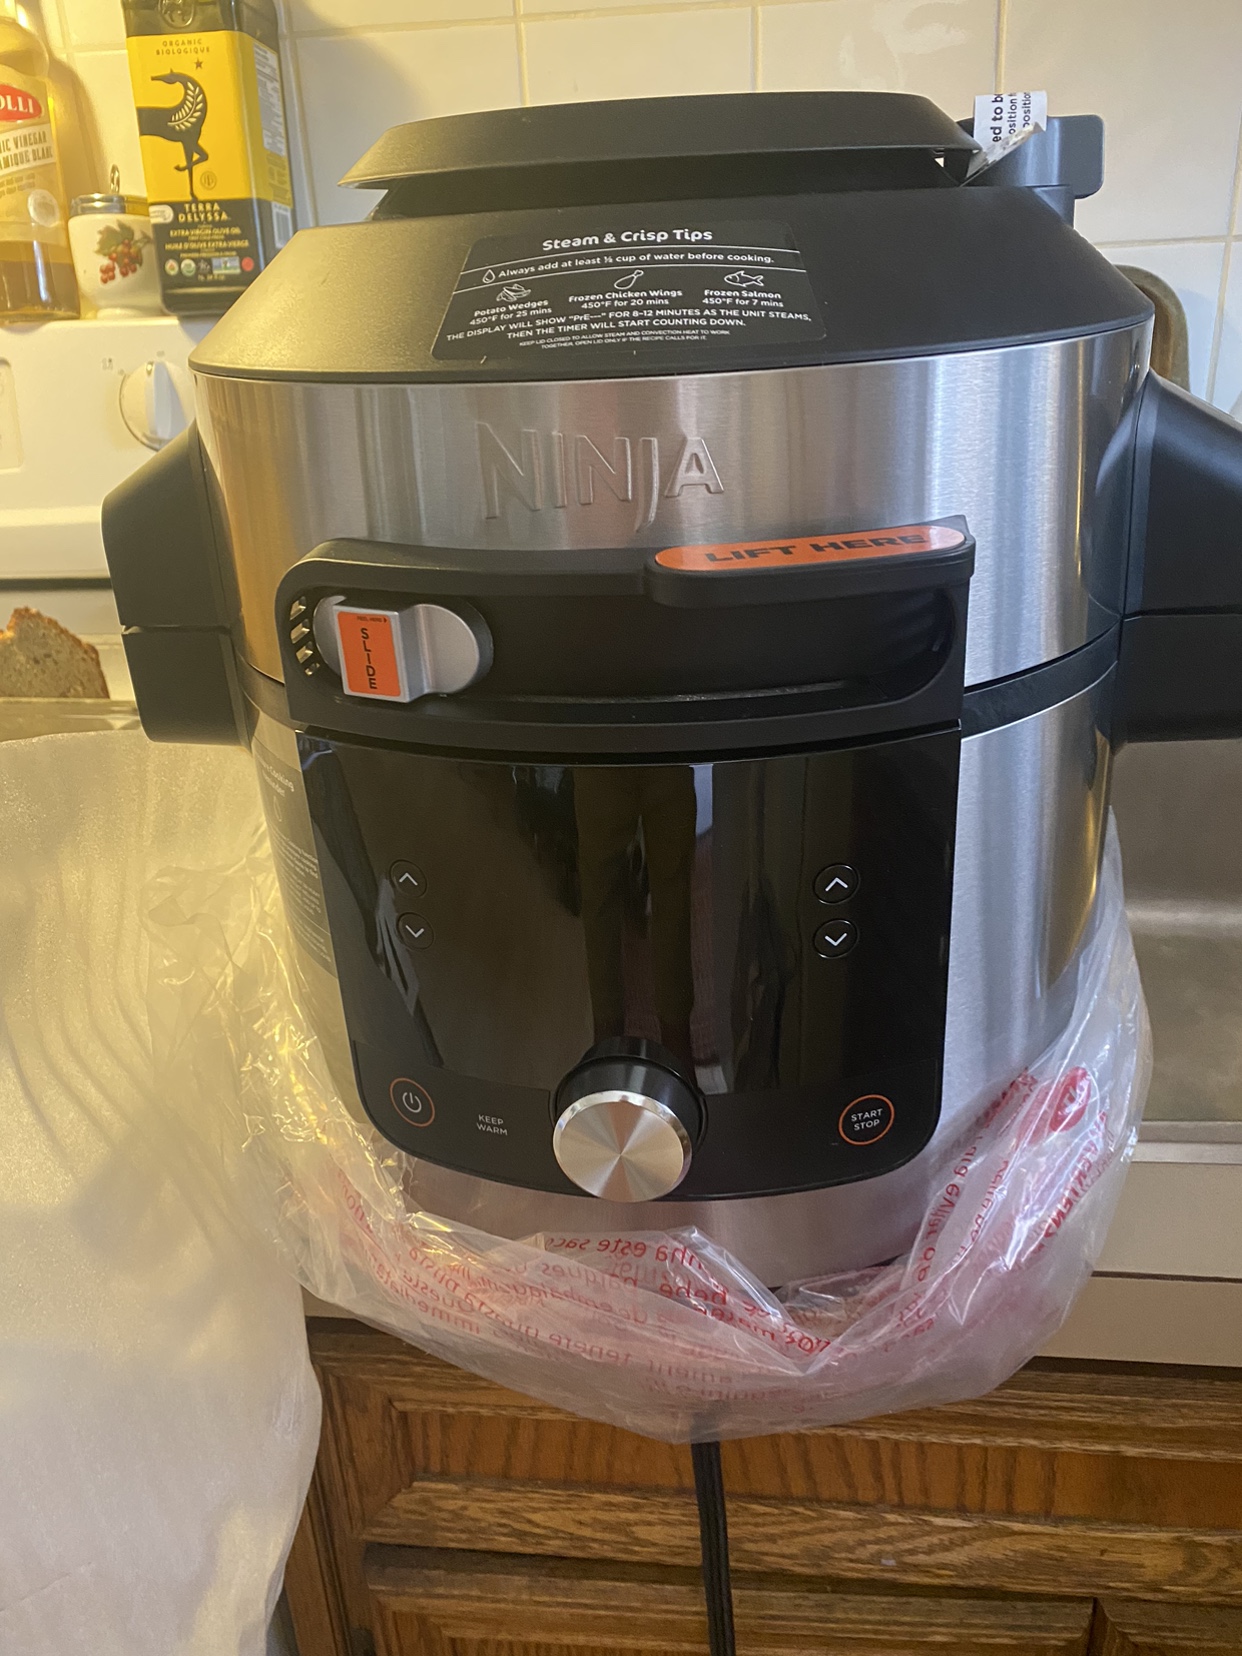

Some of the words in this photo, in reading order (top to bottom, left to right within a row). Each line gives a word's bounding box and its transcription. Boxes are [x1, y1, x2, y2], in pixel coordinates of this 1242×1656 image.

[162, 38, 202, 47] ORGANIC
[156, 46, 210, 55] BIOLOGIQUE
[991, 106, 1004, 121] to
[13, 130, 48, 150] VINEGAR
[990, 126, 1002, 142] ed
[184, 202, 220, 212] TERRA
[178, 211, 229, 223] DELYSSA
[542, 235, 599, 251] Steam
[603, 232, 617, 244] &
[620, 229, 669, 243] Crisp
[672, 228, 713, 242] Tips
[498, 266, 535, 278] Always
[538, 260, 559, 271] add
[561, 259, 573, 268] at
[575, 256, 601, 266] least
[615, 255, 636, 263] cup
[654, 252, 685, 260] water
[688, 252, 724, 261] before
[727, 253, 775, 263] cooking.
[568, 294, 603, 303] Frozen
[606, 291, 647, 300] Chicken
[649, 289, 683, 298] Wings
[702, 297, 733, 305] 450°F
[704, 289, 739, 297] Frozen
[741, 290, 781, 299] Salmon
[474, 306, 506, 317] Potato
[508, 300, 548, 312] Wedges
[581, 300, 612, 309] 450°F
[614, 299, 628, 307] for
[630, 298, 644, 306] 20
[470, 315, 498, 326] 450°F
[500, 312, 513, 321] for
[516, 310, 528, 318] 25
[530, 307, 552, 316] mins
[446, 332, 465, 341] THE
[468, 324, 506, 337] DISPLAY
[509, 320, 533, 331] WILL
[535, 315, 566, 327] SHOW
[608, 311, 630, 319] FOR
[656, 308, 700, 317] MINUTES
[720, 309, 739, 317] THE
[742, 310, 766, 318] UNIT
[769, 311, 812, 322] STEAMS,
[507, 330, 533, 339] THEN
[536, 327, 555, 336] THE
[557, 323, 588, 333] TIMER
[590, 321, 616, 330] WILL
[618, 319, 650, 328] START
[653, 318, 707, 327] COUNTING
[710, 318, 746, 327] DOWN.
[474, 421, 724, 532] NINJA
[705, 545, 796, 563] LIFT
[809, 534, 926, 553] HERE
[361, 627, 378, 690] SLIDE
[478, 1114, 504, 1125] KEEP
[851, 1108, 883, 1121] START
[476, 1122, 508, 1136] WARM
[854, 1119, 880, 1131] STOP
